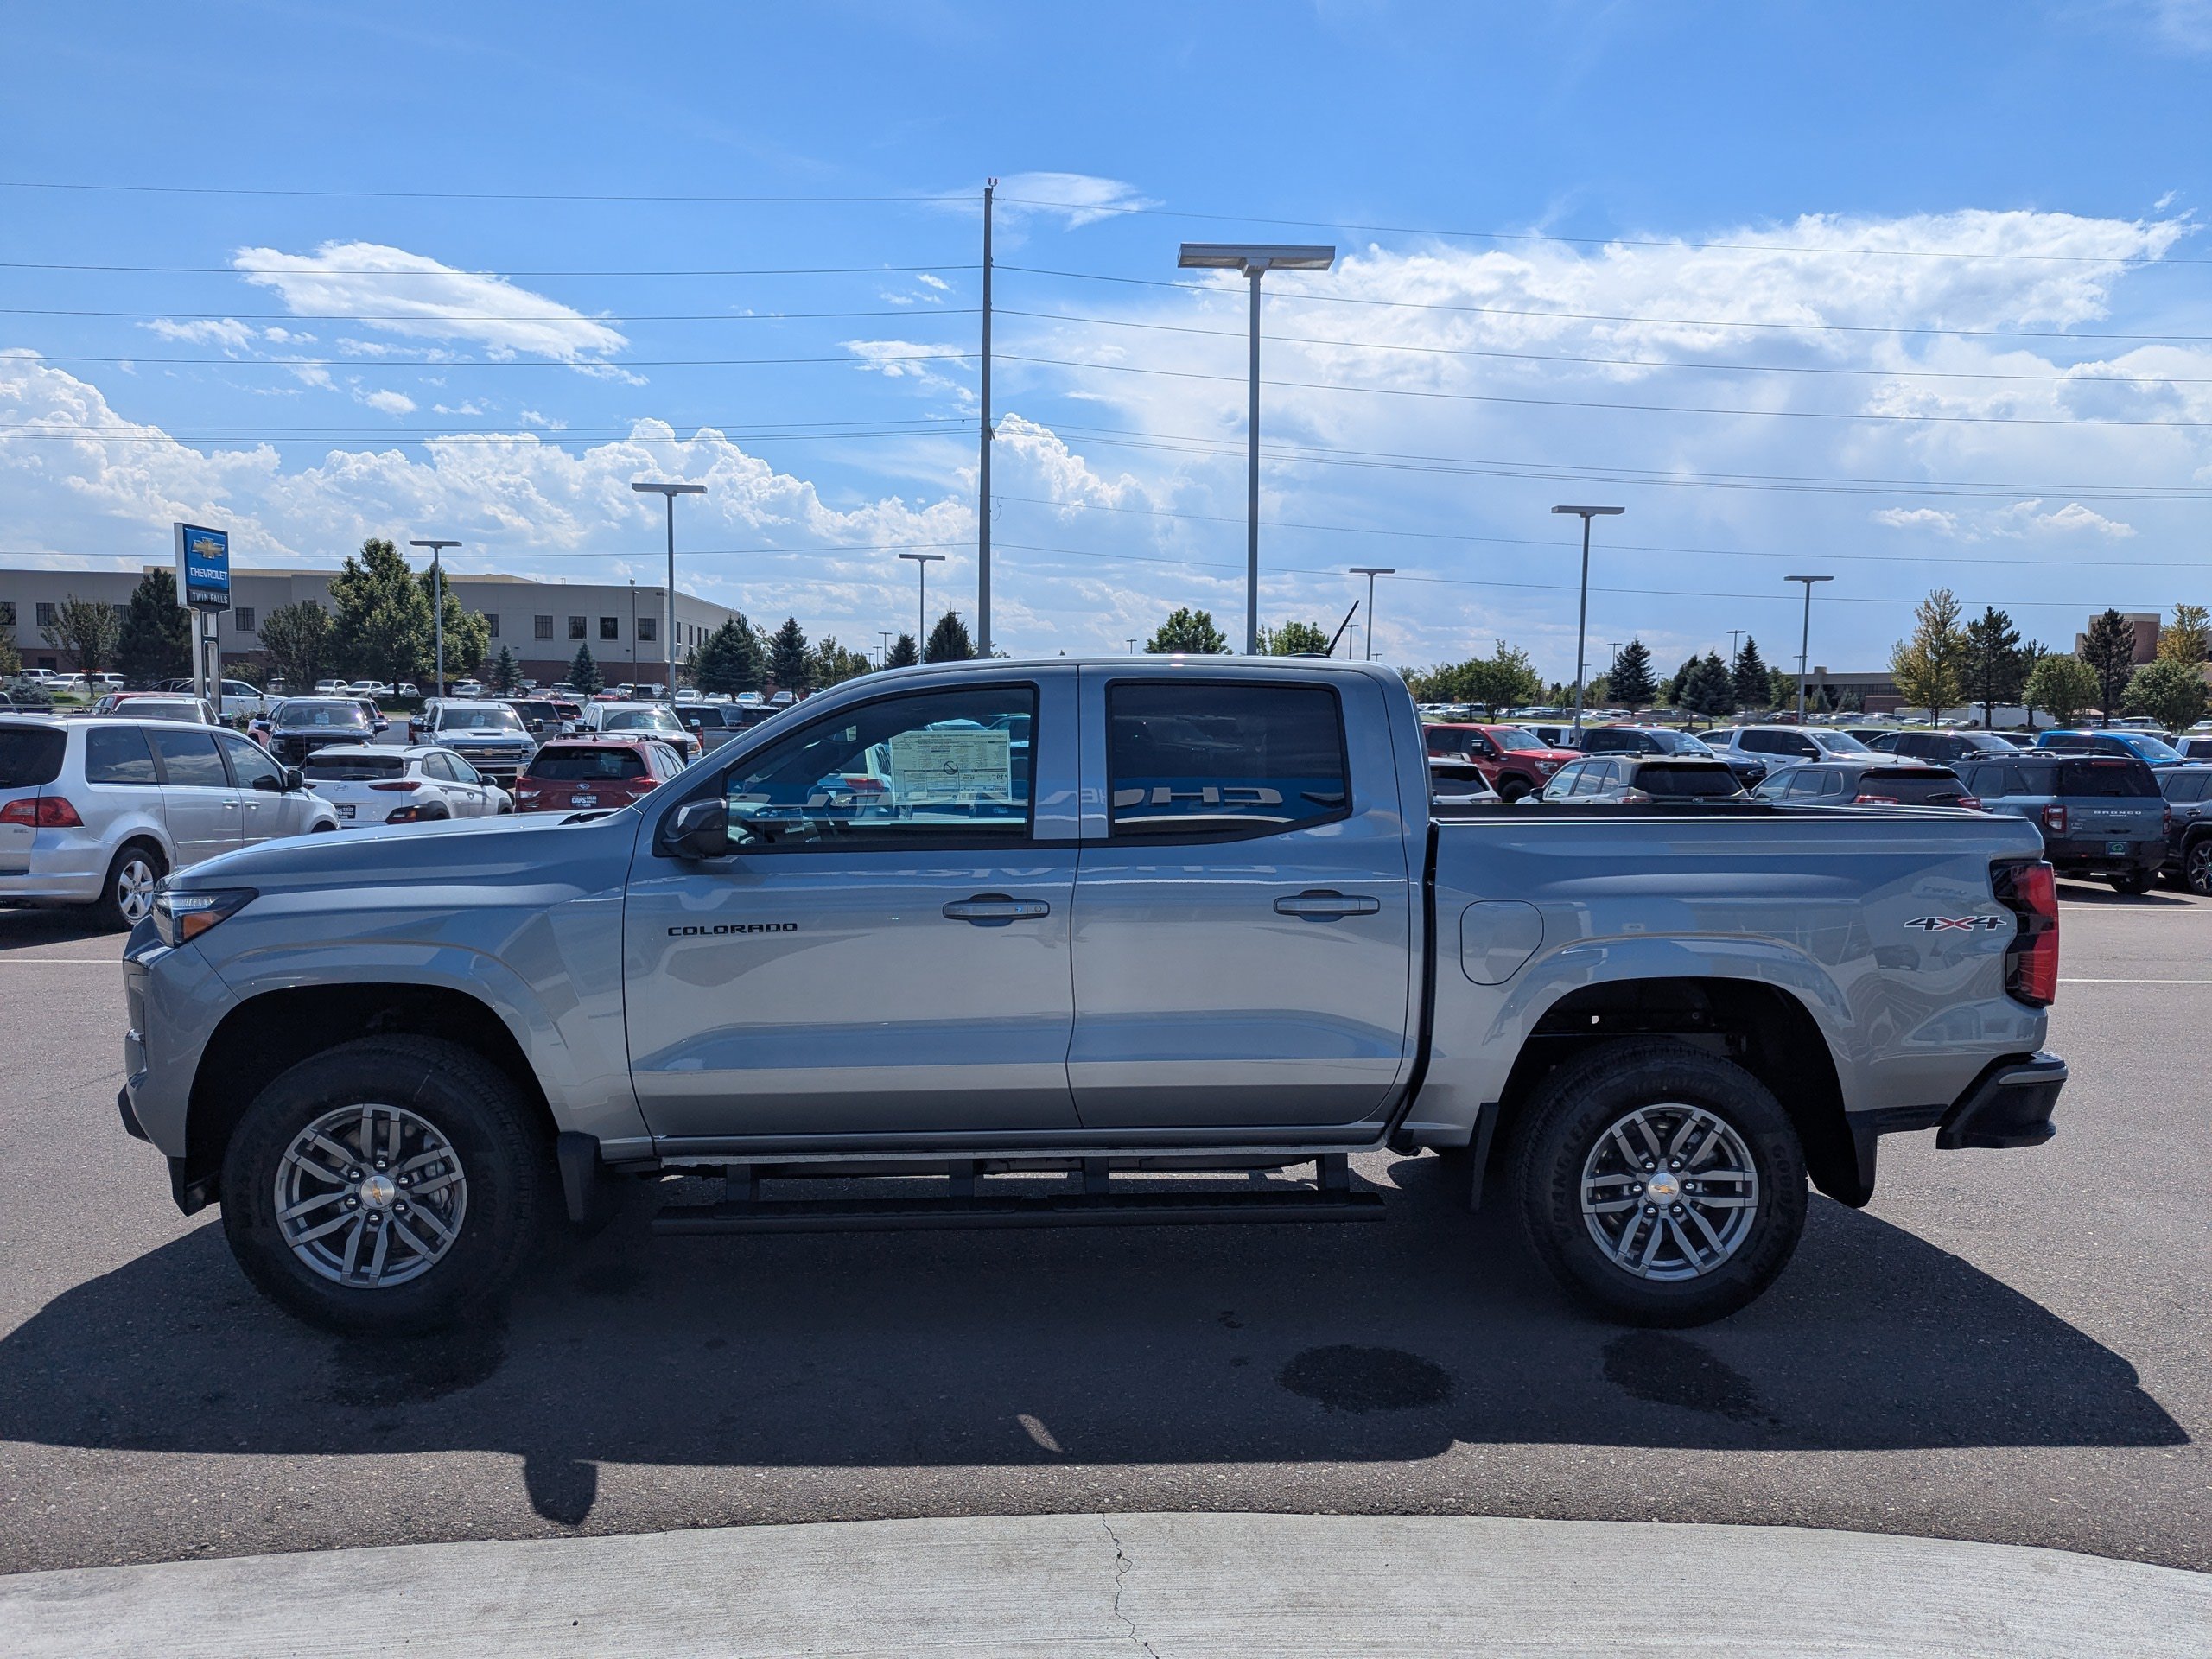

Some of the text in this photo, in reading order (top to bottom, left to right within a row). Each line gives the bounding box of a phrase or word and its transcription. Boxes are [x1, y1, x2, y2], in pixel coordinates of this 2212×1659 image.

[190, 567, 228, 581] CHEVROLET
[192, 592, 228, 604] TWIN FALLS
[668, 923, 798, 937] COLORADO
